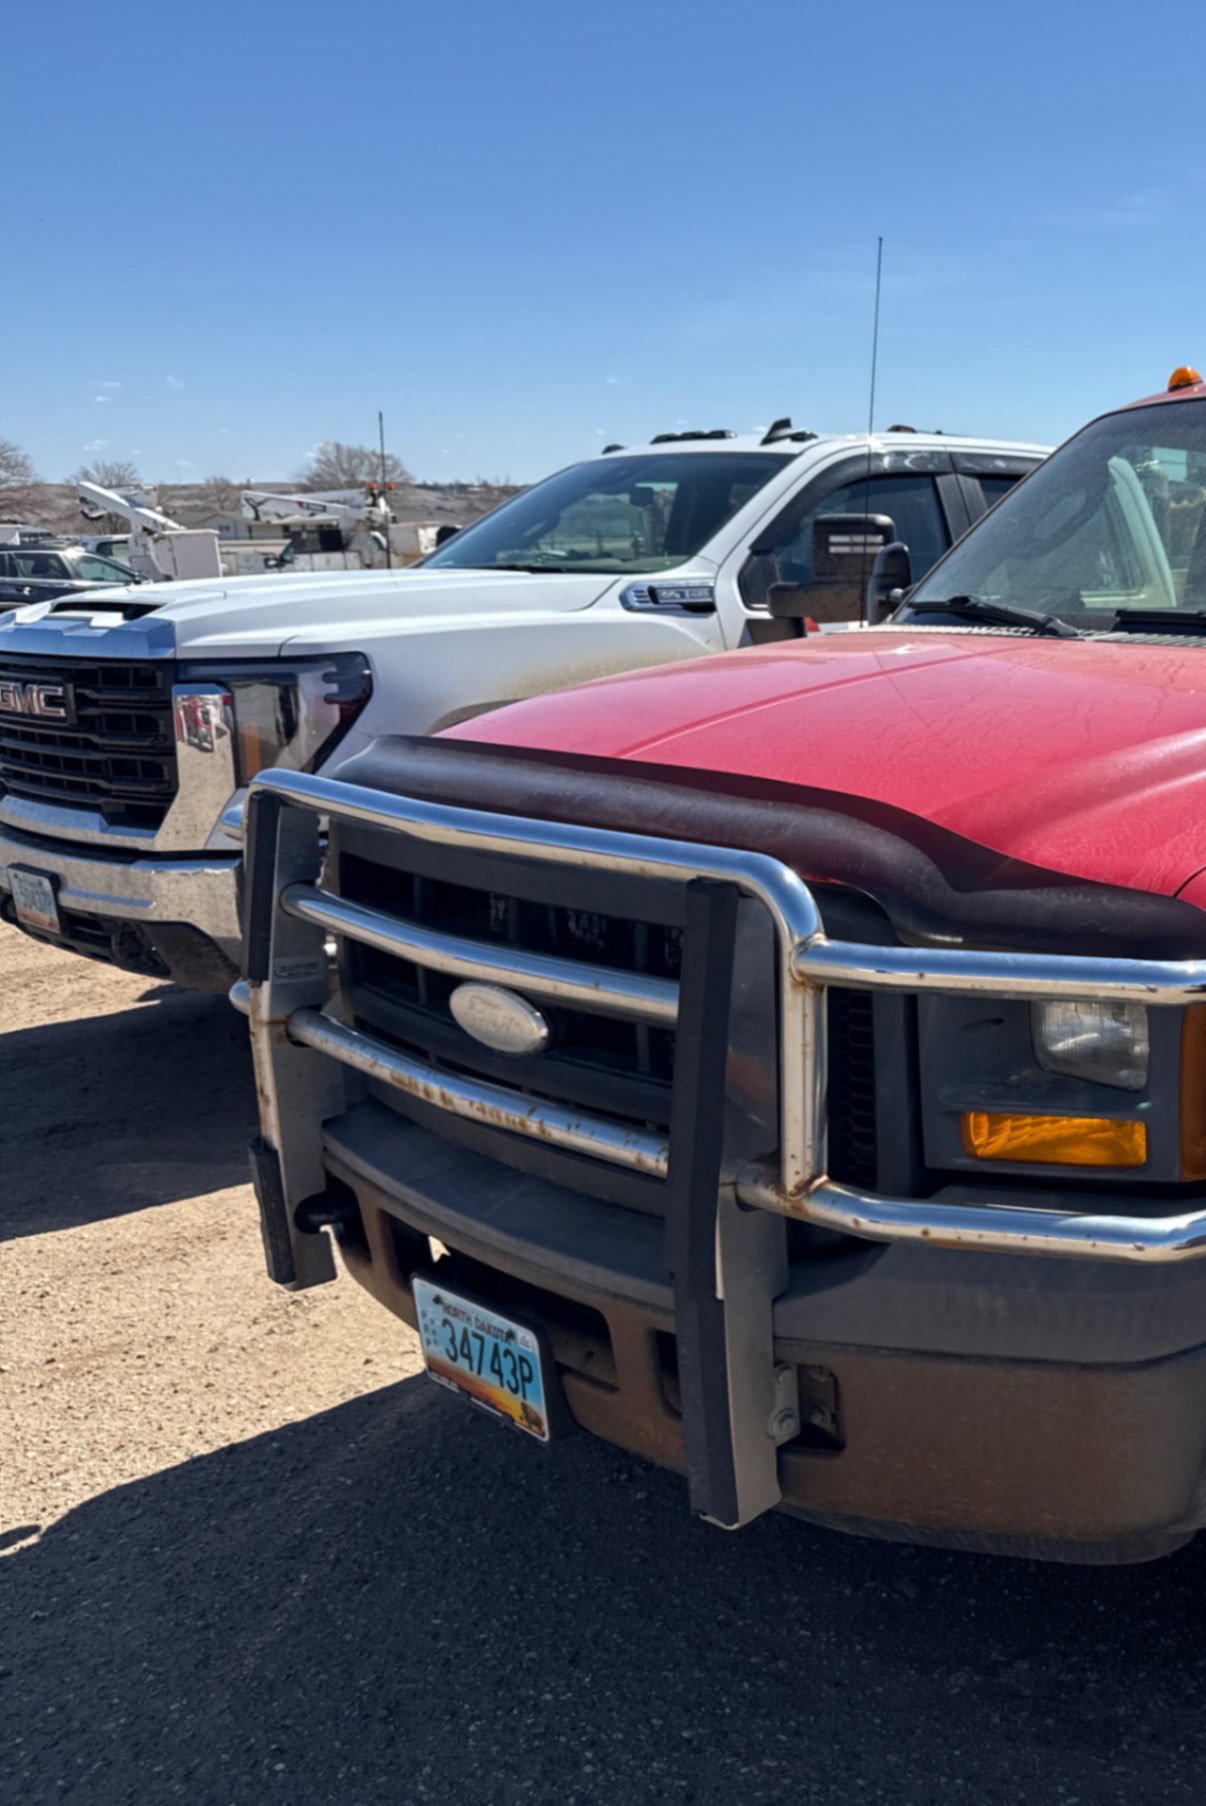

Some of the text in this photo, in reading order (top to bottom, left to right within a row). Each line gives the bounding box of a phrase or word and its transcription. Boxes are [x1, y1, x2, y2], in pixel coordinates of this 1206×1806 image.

[0, 680, 66, 717] GMC
[443, 1302, 473, 1326] NORTH
[441, 1318, 534, 1401] 34743P
